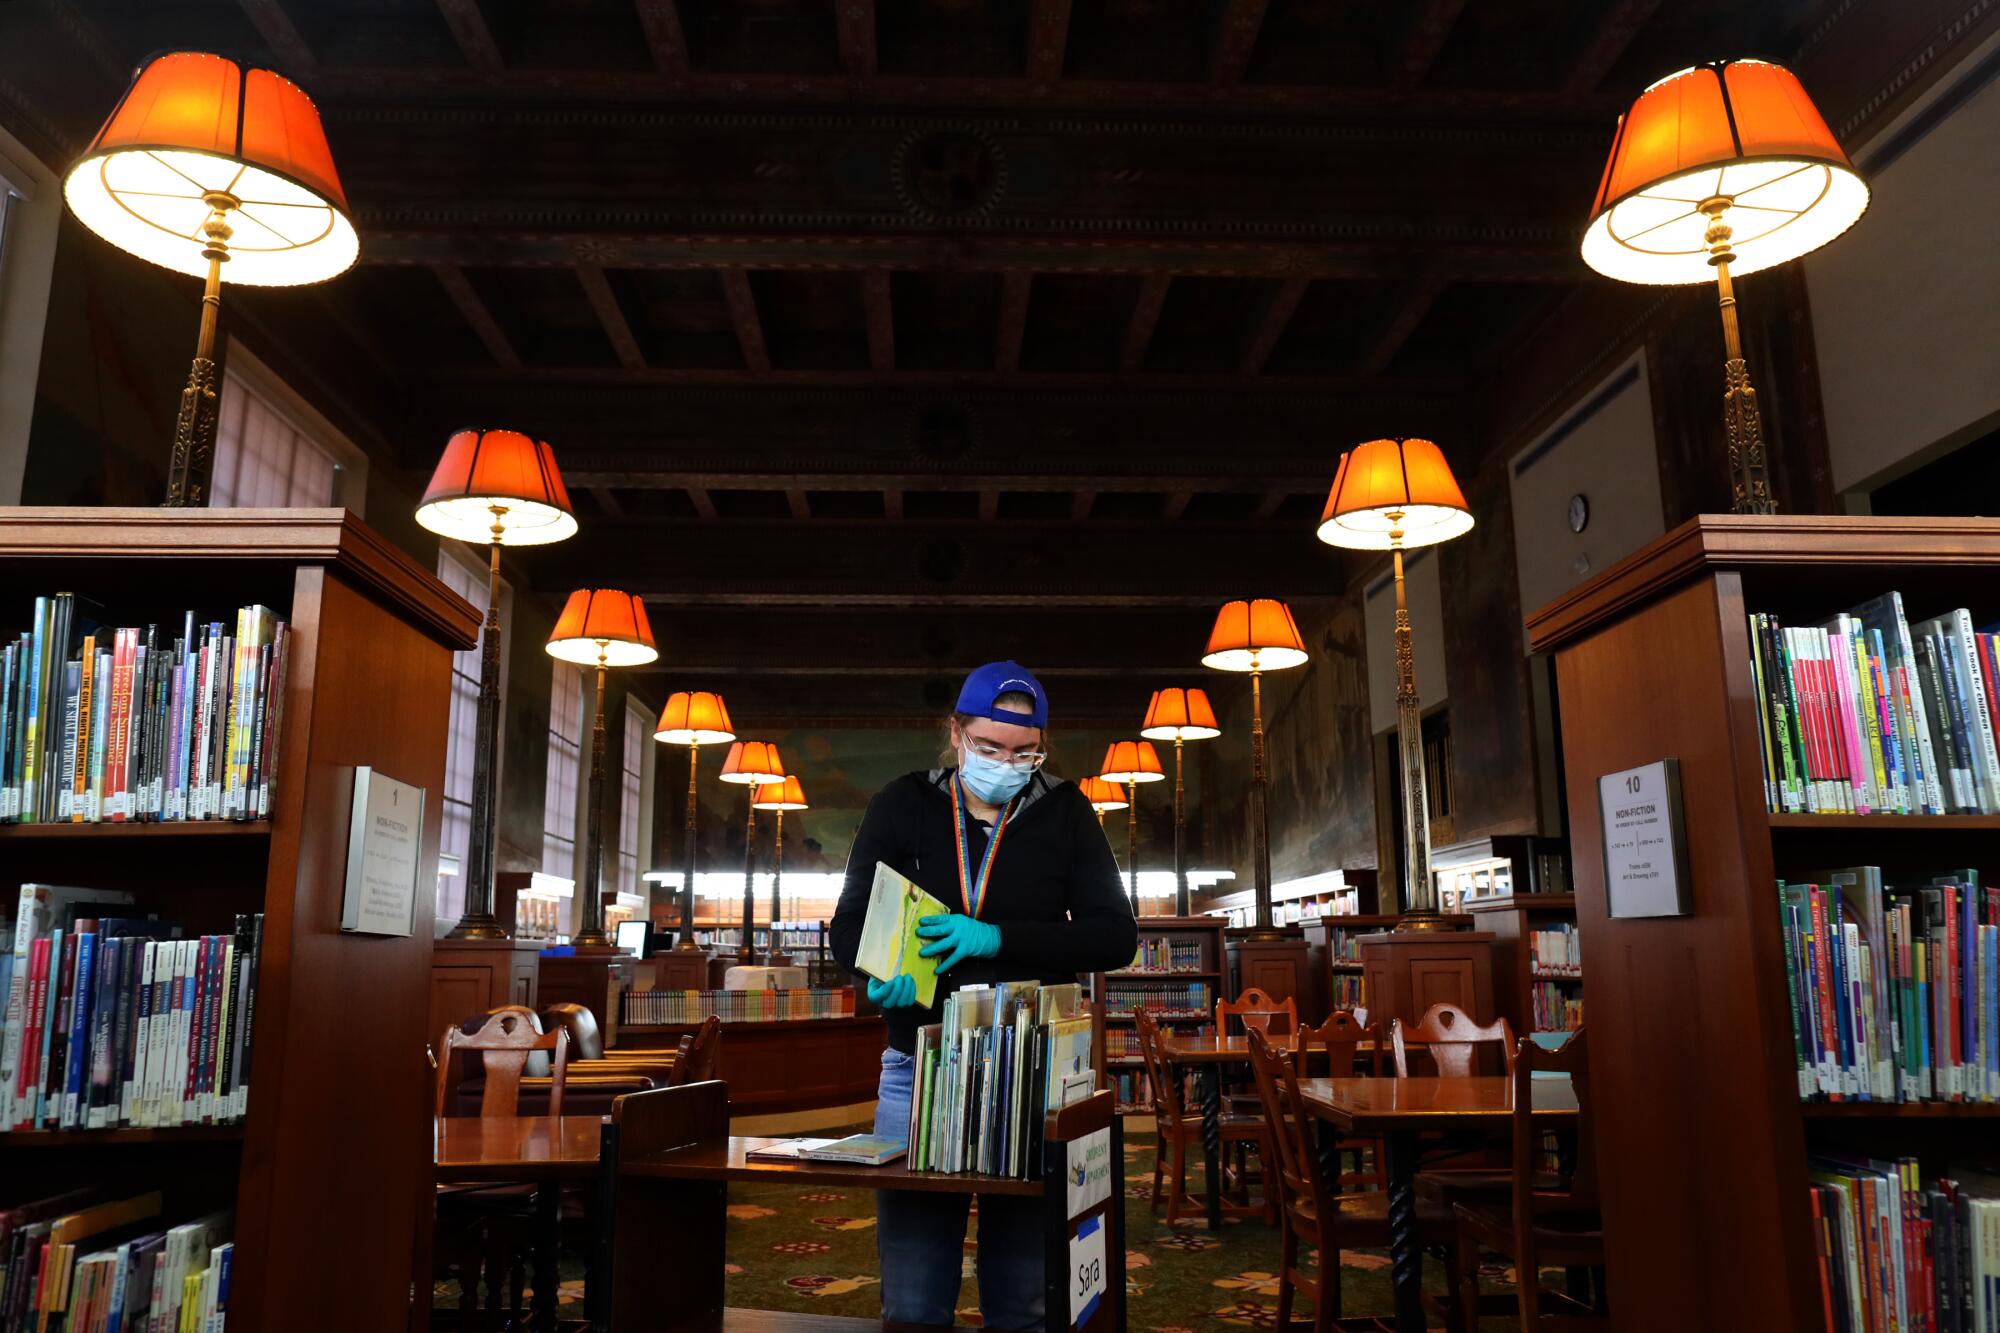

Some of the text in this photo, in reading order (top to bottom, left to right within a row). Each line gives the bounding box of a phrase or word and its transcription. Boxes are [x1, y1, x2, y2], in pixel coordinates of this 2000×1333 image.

[66, 695, 78, 708] WE
[81, 691, 89, 709] CIVIL
[1969, 651, 1979, 675] book
[1976, 693, 1989, 730] children
[65, 709, 77, 737] SHALL
[80, 711, 88, 736] RIGHTS
[107, 665, 123, 767] Freedom Summer
[117, 665, 134, 767] Freedom Summer
[1867, 715, 1878, 741] ART
[61, 739, 76, 782] OVERCOME
[77, 738, 86, 777] MOVEMENT
[253, 741, 261, 770] MOVEMENT
[393, 788, 398, 806] 1
[1626, 775, 1641, 794] 10
[1615, 804, 1656, 819] NON-FICTION
[21, 903, 30, 921] David
[1812, 909, 1820, 924] THE
[1813, 926, 1823, 956] SCHOOL
[1818, 970, 1826, 984] ART
[75, 991, 86, 1029] AMERICANS
[203, 994, 211, 1026] MEXICANS
[212, 996, 220, 1023] ITALIANS
[191, 1034, 199, 1062] AMERICA
[199, 1037, 208, 1066] AMERICA
[208, 1034, 217, 1062] AMERICA
[1078, 1258, 1099, 1297] Sara
